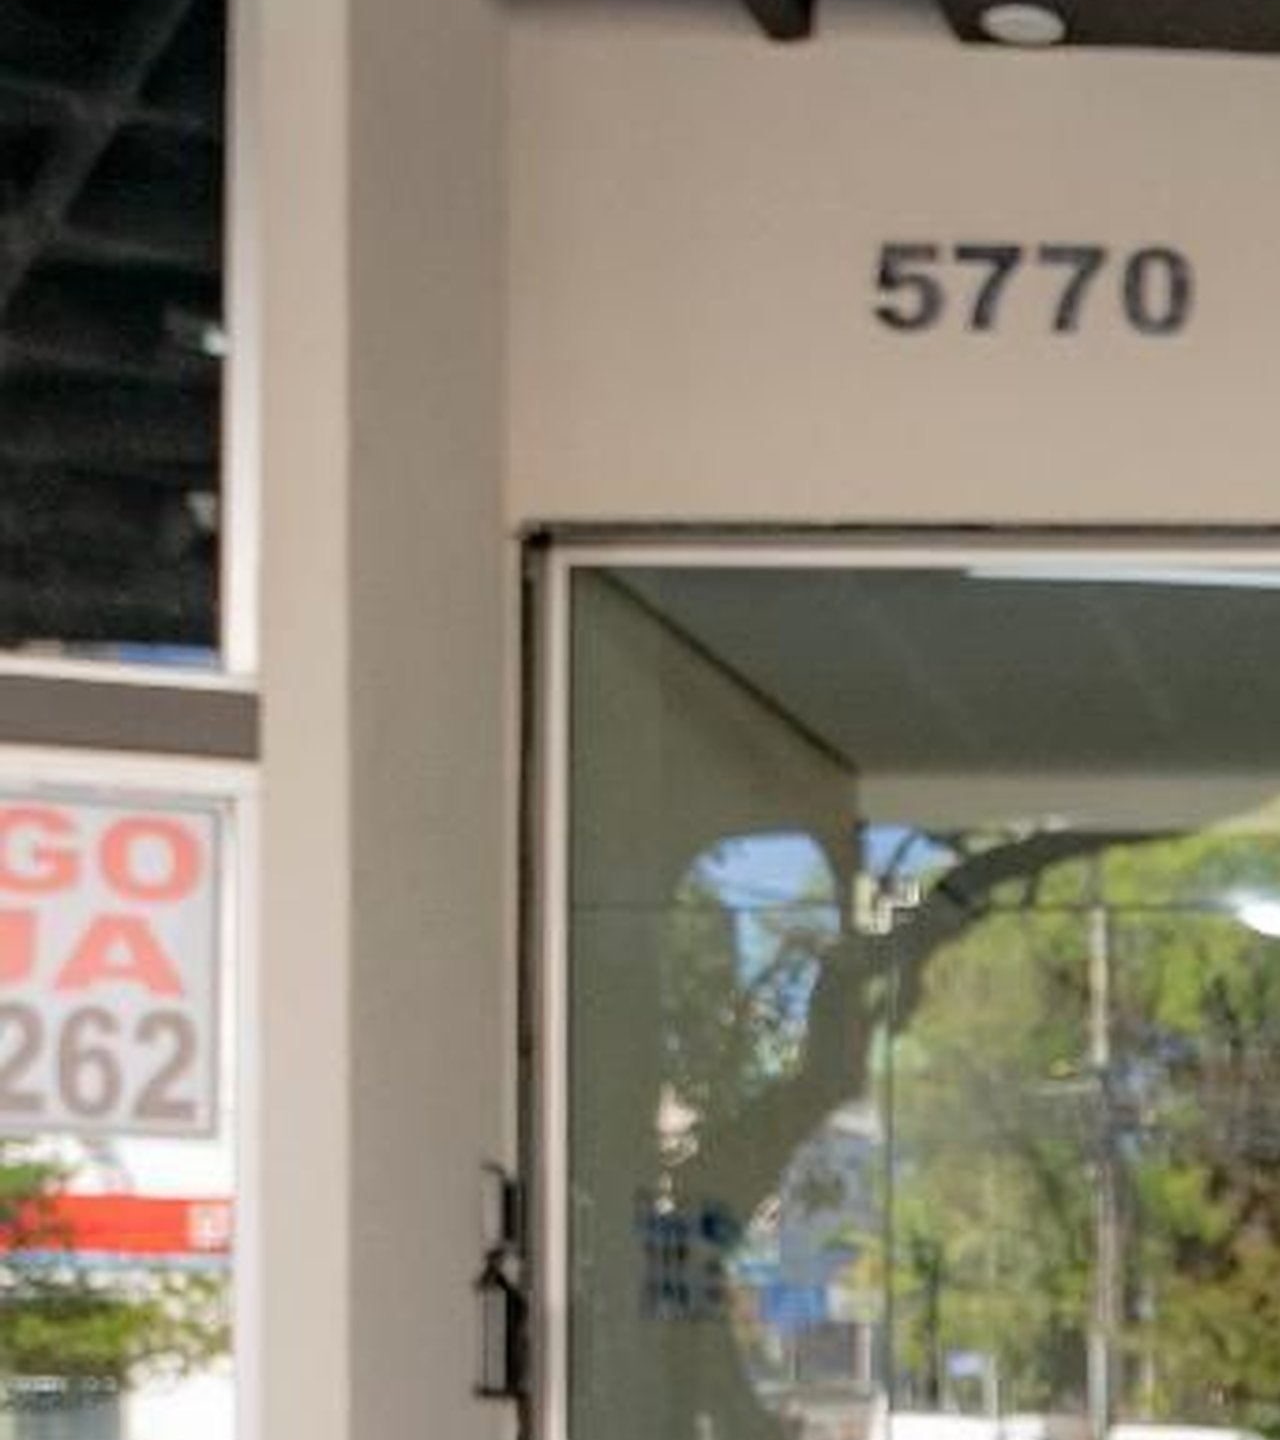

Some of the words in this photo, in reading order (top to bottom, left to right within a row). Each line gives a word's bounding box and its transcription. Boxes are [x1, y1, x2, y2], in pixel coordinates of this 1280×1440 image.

[874, 242, 1194, 335] 5770
[0, 803, 202, 904] GO
[0, 1002, 196, 1122] 262
